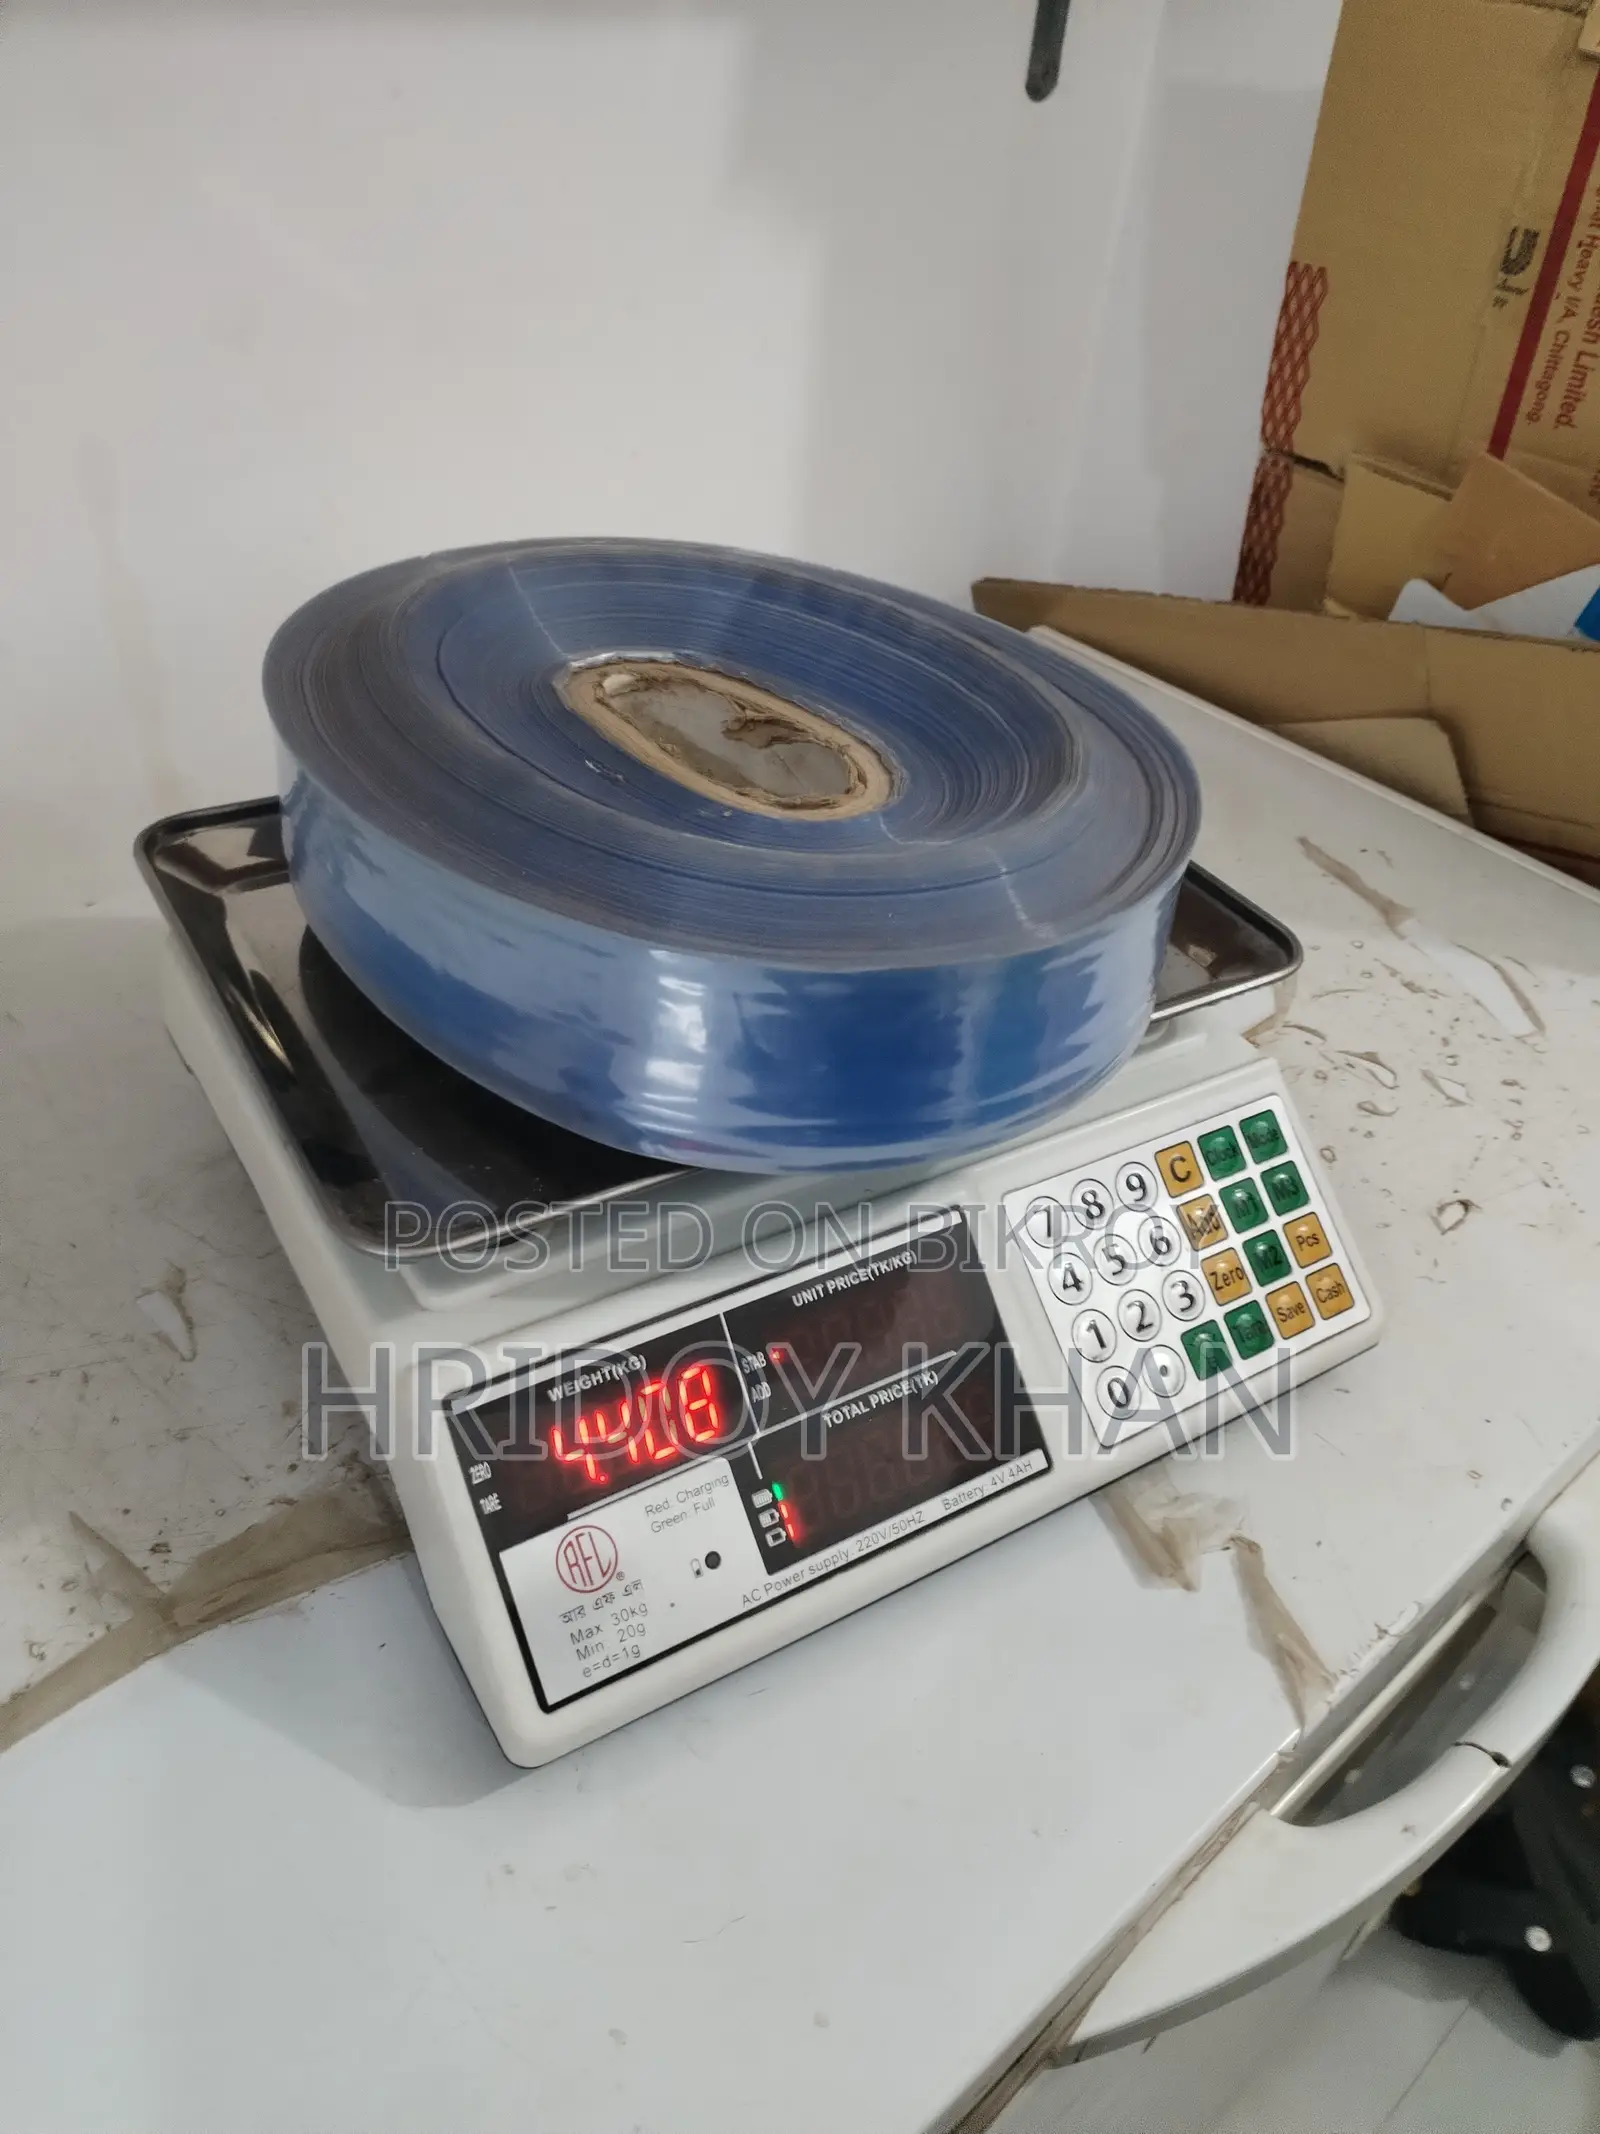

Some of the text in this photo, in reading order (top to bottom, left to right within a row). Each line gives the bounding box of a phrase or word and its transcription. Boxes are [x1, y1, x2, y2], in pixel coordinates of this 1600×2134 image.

[1170, 1155, 1192, 1183] C
[1126, 1172, 1149, 1202] 9
[1081, 1188, 1106, 1220] 8
[1034, 1206, 1053, 1239] 7
[1148, 1225, 1172, 1256] 6
[1295, 1232, 1320, 1252] Pcs
[1102, 1244, 1126, 1277] 5
[792, 1249, 918, 1307] UNIT PRICE(TK/KG)
[1061, 1261, 1084, 1293] 4
[1209, 1265, 1245, 1292] Zero
[1315, 1280, 1345, 1303] Cash
[1170, 1278, 1195, 1313] 3
[1128, 1299, 1154, 1333] 2
[1276, 1301, 1306, 1323] Save
[1086, 1318, 1108, 1351] 1
[547, 1354, 648, 1402] WEIGHT(KG)
[741, 1351, 767, 1375] STAB
[750, 1381, 772, 1403] ADD
[822, 1370, 940, 1428] TOTAL PRICE(TK)
[1106, 1376, 1131, 1409] 0
[468, 1460, 492, 1486] ZERO
[479, 1492, 503, 1515] TARE
[676, 1474, 730, 1504] Charging
[693, 1496, 716, 1515] Full
[563, 1530, 613, 1588] RFL
[740, 1588, 762, 1609] AC
[764, 1568, 807, 1598] Power
[855, 1510, 927, 1554] 220V/50HZ
[610, 1602, 650, 1627] 30kg
[616, 1622, 648, 1644] 20g
[582, 1644, 642, 1679] e=d=1g
